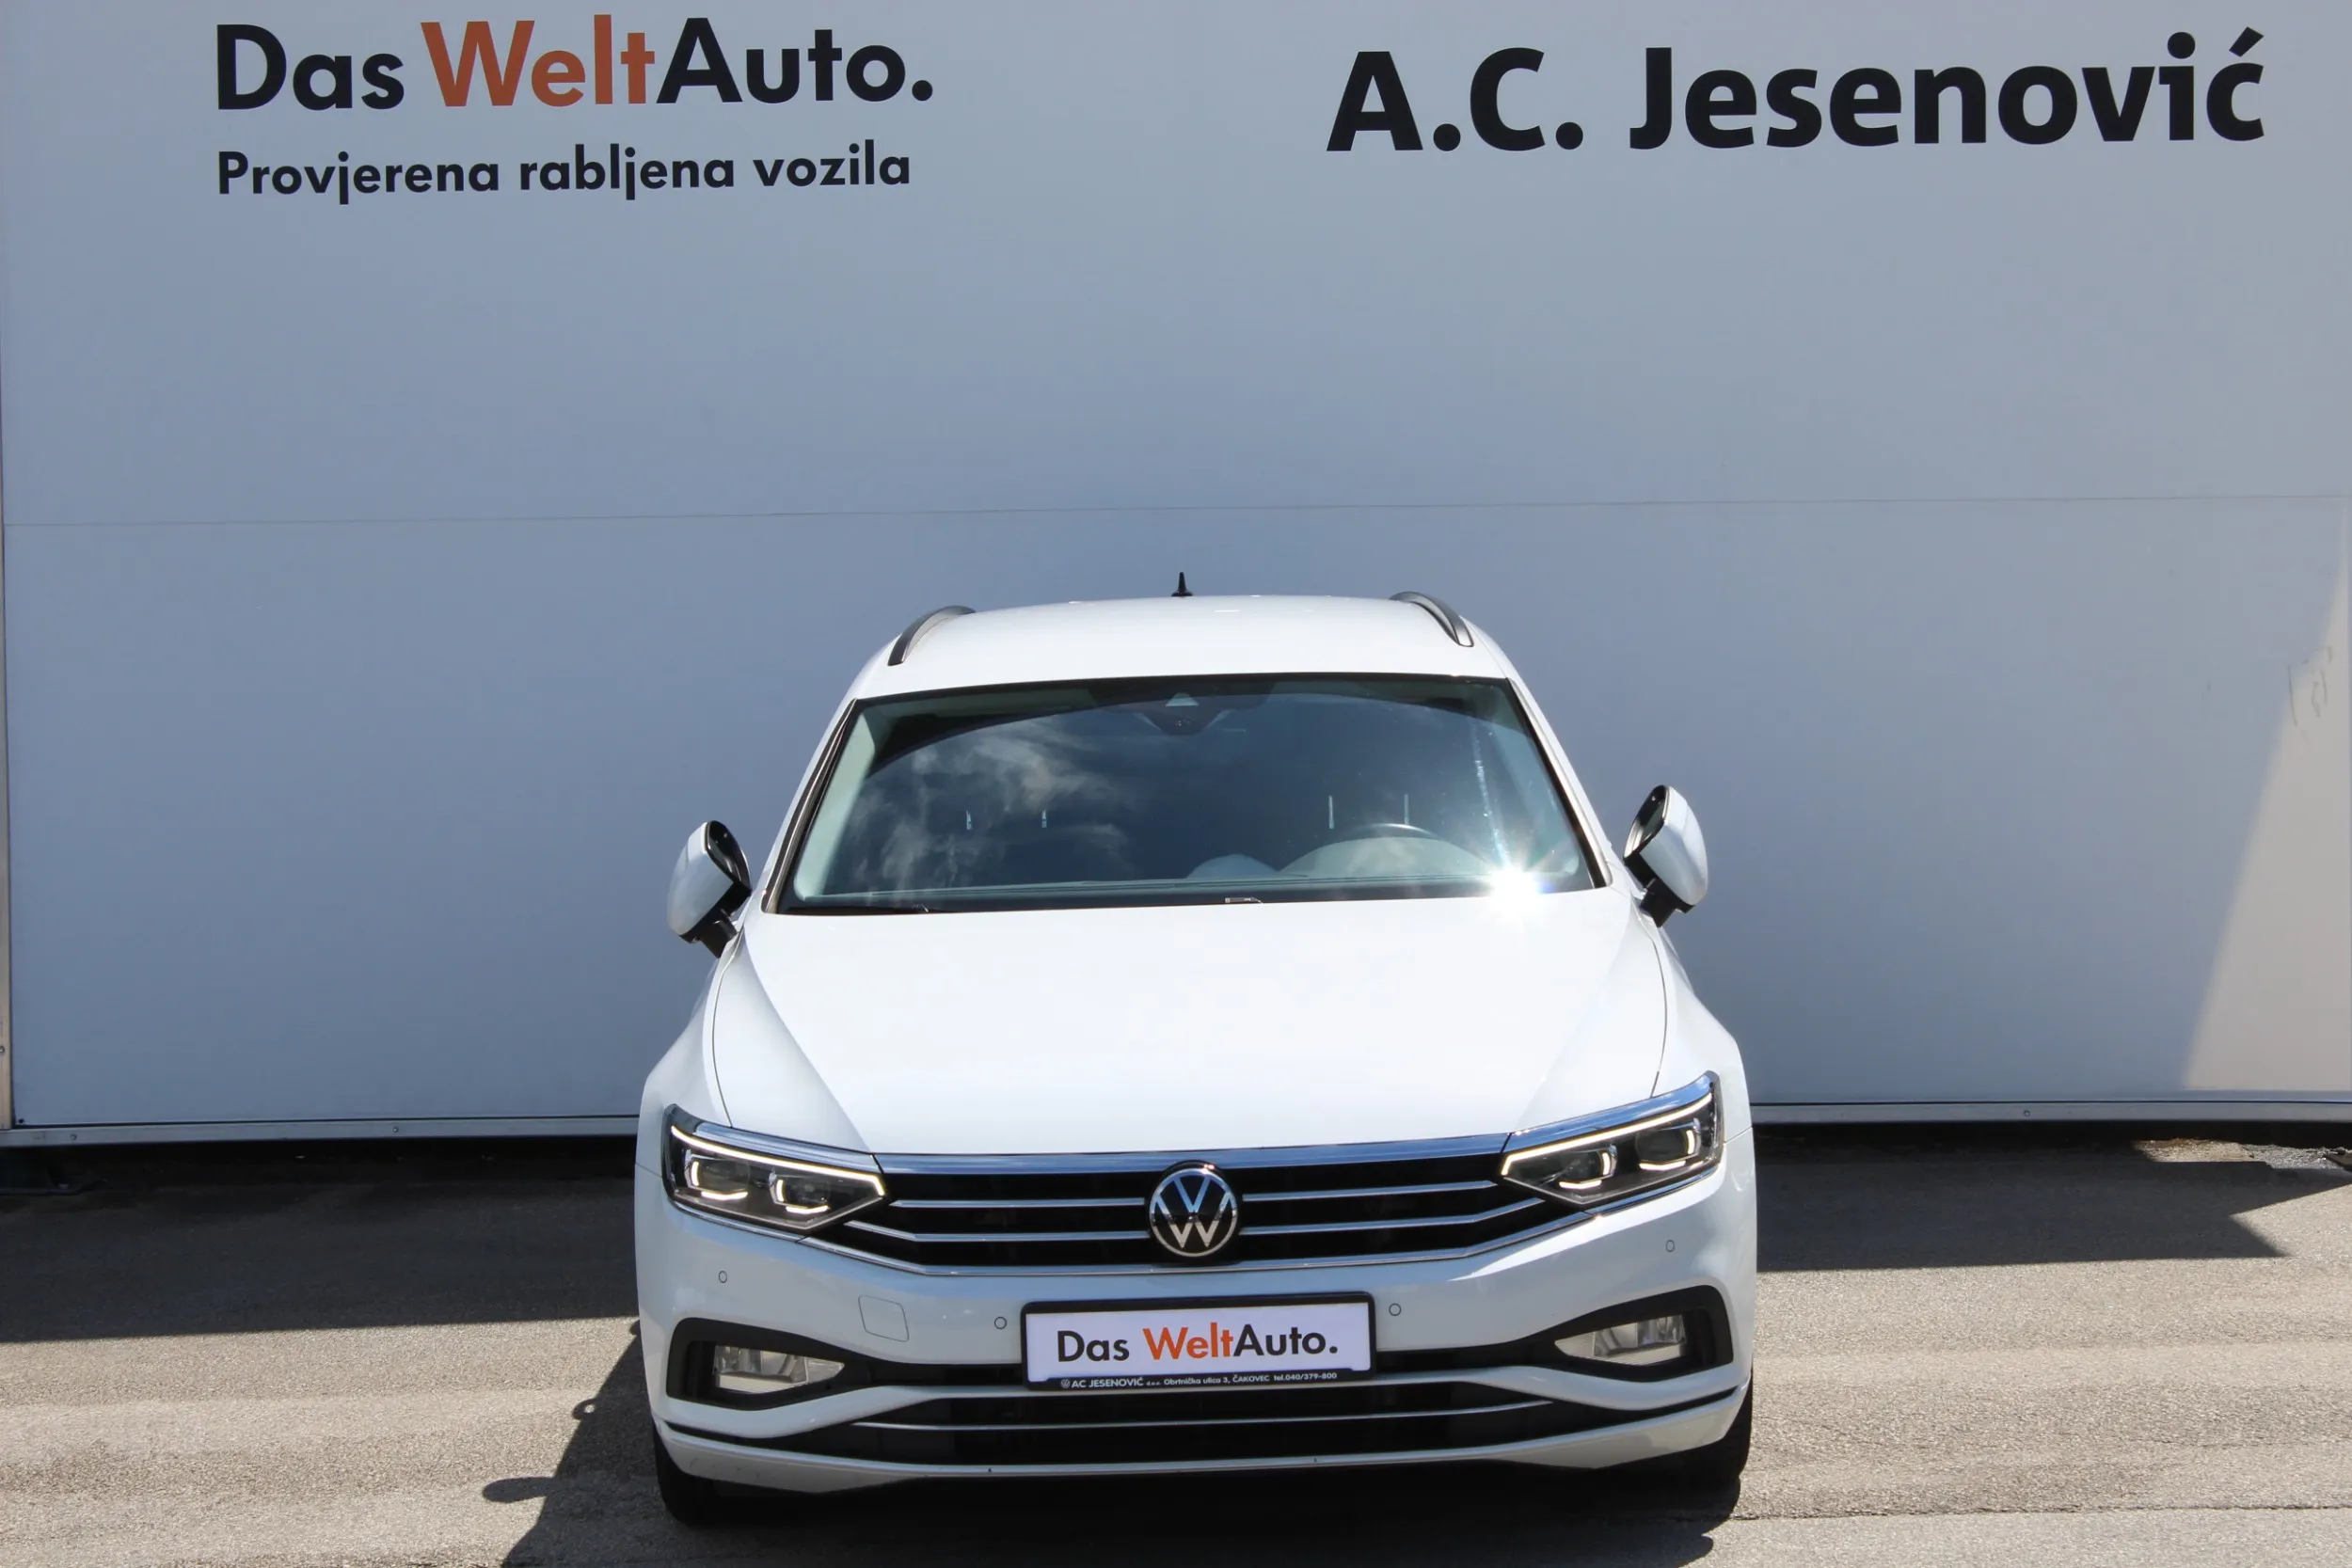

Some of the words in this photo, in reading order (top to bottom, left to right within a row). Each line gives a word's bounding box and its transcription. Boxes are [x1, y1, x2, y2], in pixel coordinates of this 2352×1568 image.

[217, 24, 405, 111] Das
[420, 14, 933, 107] WeltAuto.
[1326, 47, 1584, 152] A.C.
[1629, 26, 2265, 150] Jesenović
[218, 150, 500, 205] Provjerena
[519, 143, 735, 201] rabljena
[752, 138, 910, 187] vozila
[1057, 1330, 1130, 1363] Das
[1142, 1322, 1339, 1361] WeltAuto.
[1071, 1380, 1087, 1388] AC
[1089, 1377, 1144, 1387] JESENOVIĆ
[1232, 1374, 1270, 1383] ČAKOVEC
